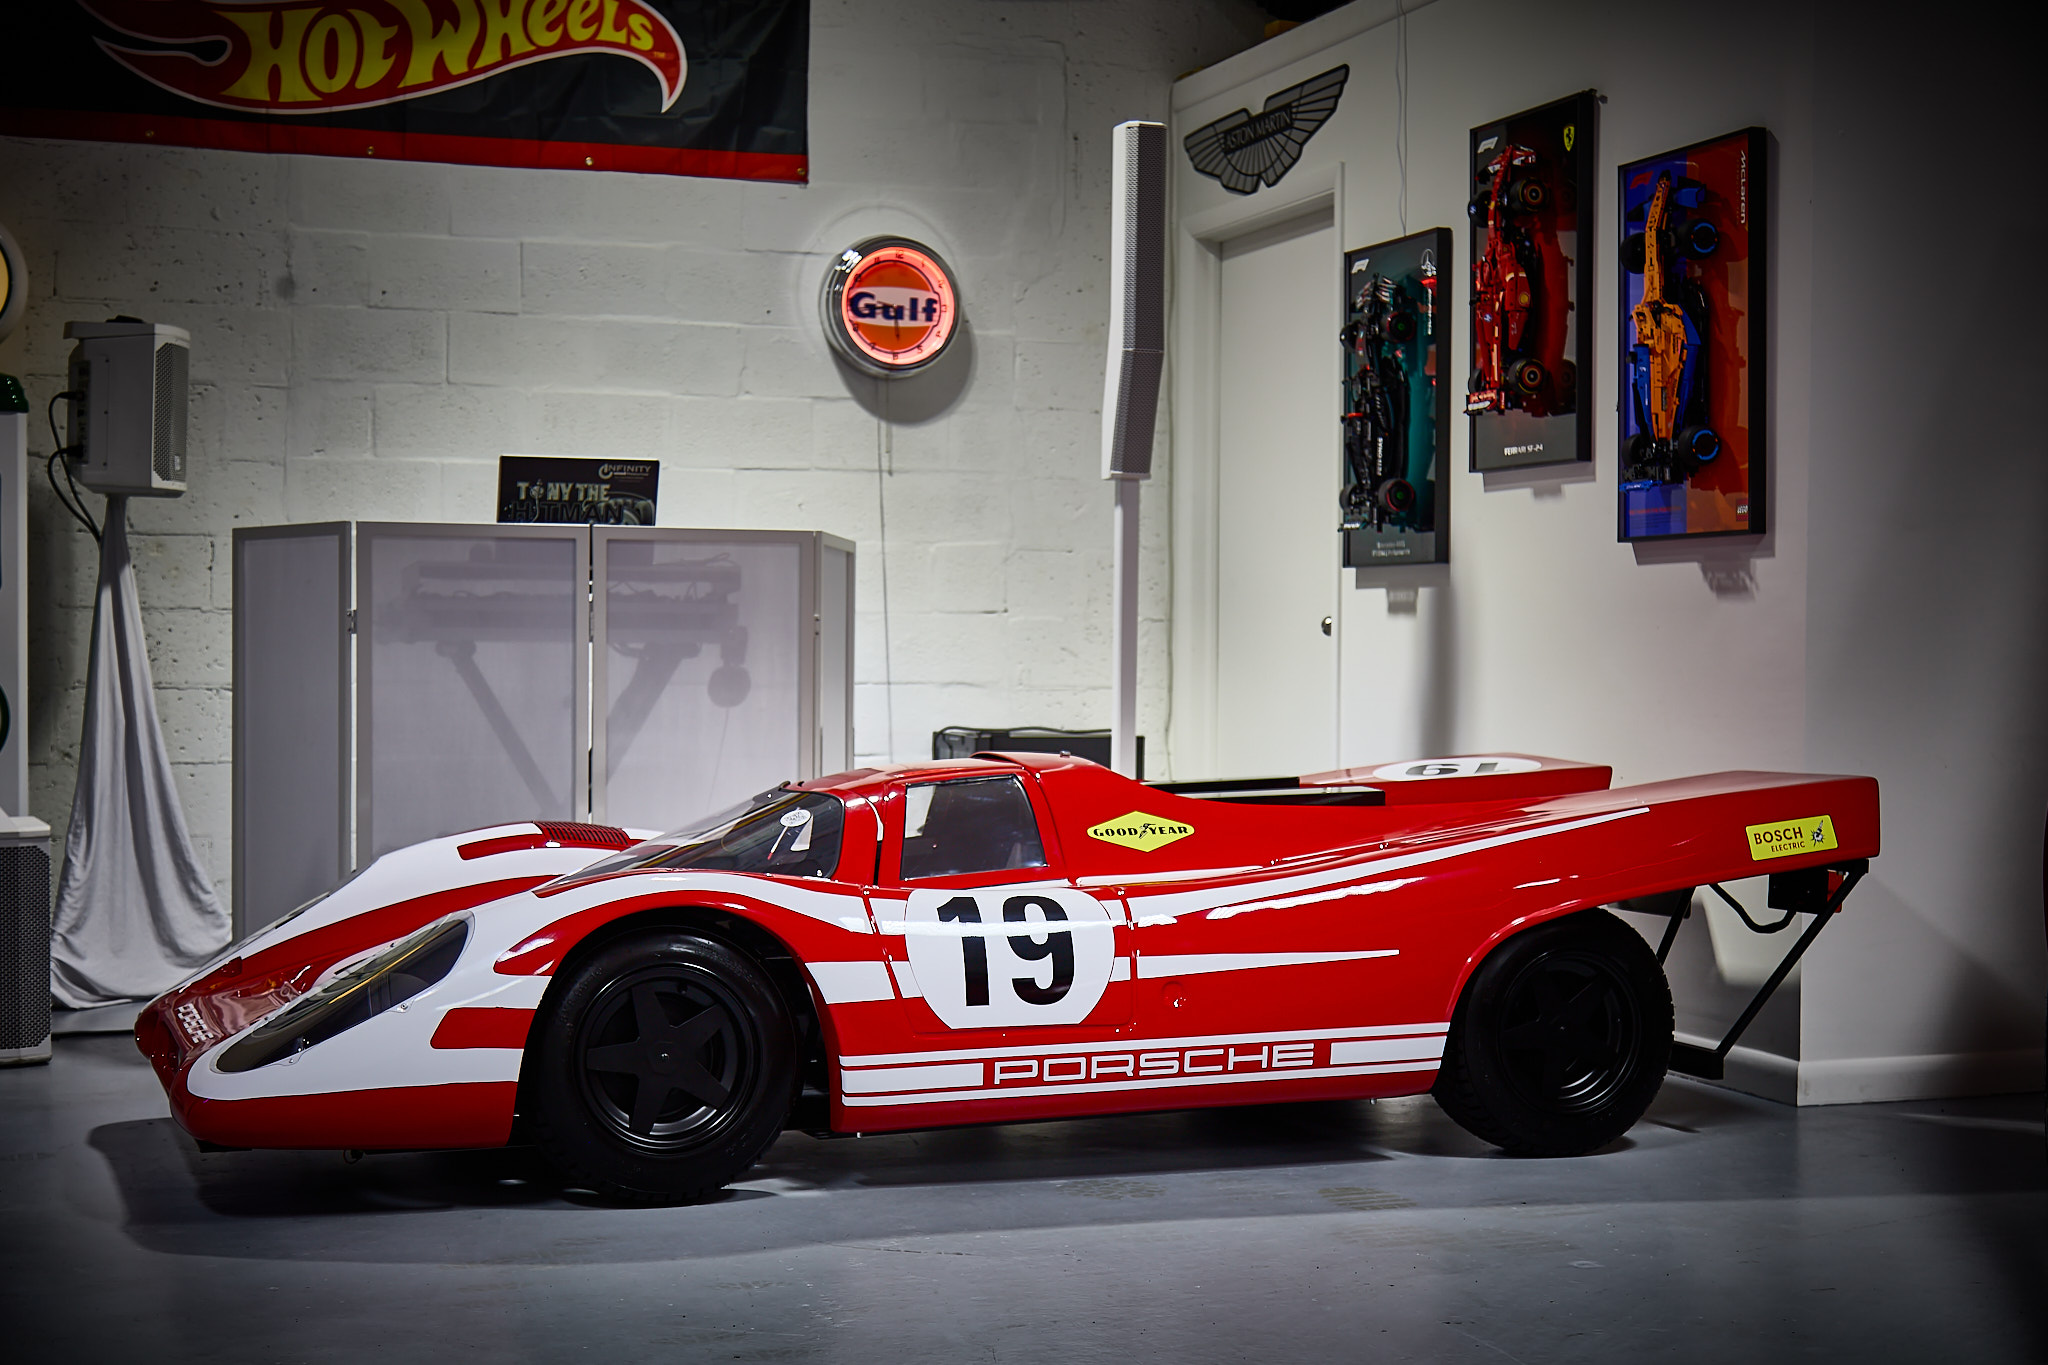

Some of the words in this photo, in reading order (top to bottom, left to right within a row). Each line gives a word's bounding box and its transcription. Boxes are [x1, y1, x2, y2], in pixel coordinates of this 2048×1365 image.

[1225, 125, 1255, 149] ASTON
[1255, 109, 1291, 137] MARTIN
[850, 291, 938, 322] Gulf
[575, 483, 611, 501] THE
[1754, 827, 1803, 844] BOSCH
[1771, 841, 1805, 852] ELECTRIC
[937, 896, 1075, 1006] 19
[994, 1043, 1314, 1084] PORSCHE
